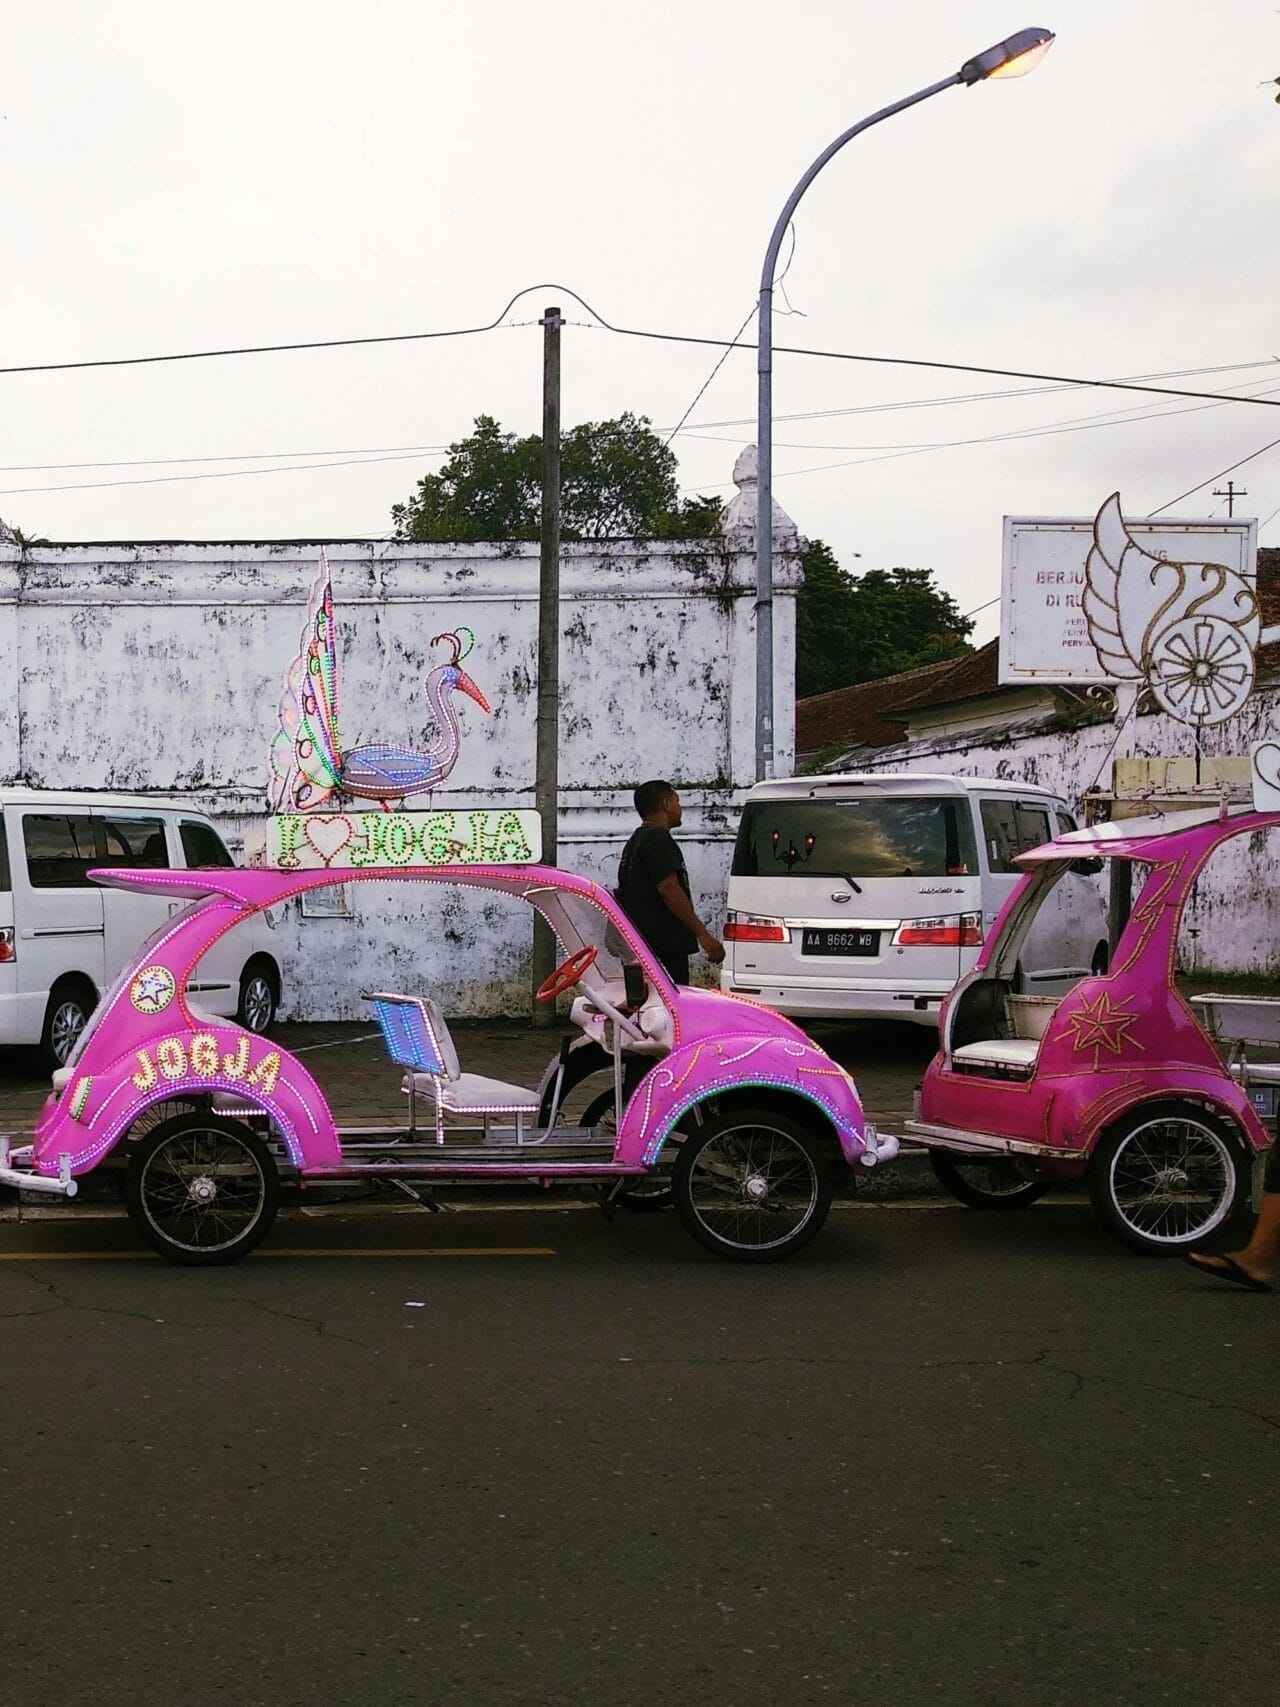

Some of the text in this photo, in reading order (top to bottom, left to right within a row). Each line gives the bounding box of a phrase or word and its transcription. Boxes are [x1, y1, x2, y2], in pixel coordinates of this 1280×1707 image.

[1035, 571, 1084, 584] BERJU
[277, 811, 532, 867] I JOGJA
[807, 933, 872, 946] AA 8662 WB
[132, 1033, 281, 1095] JOGJA
